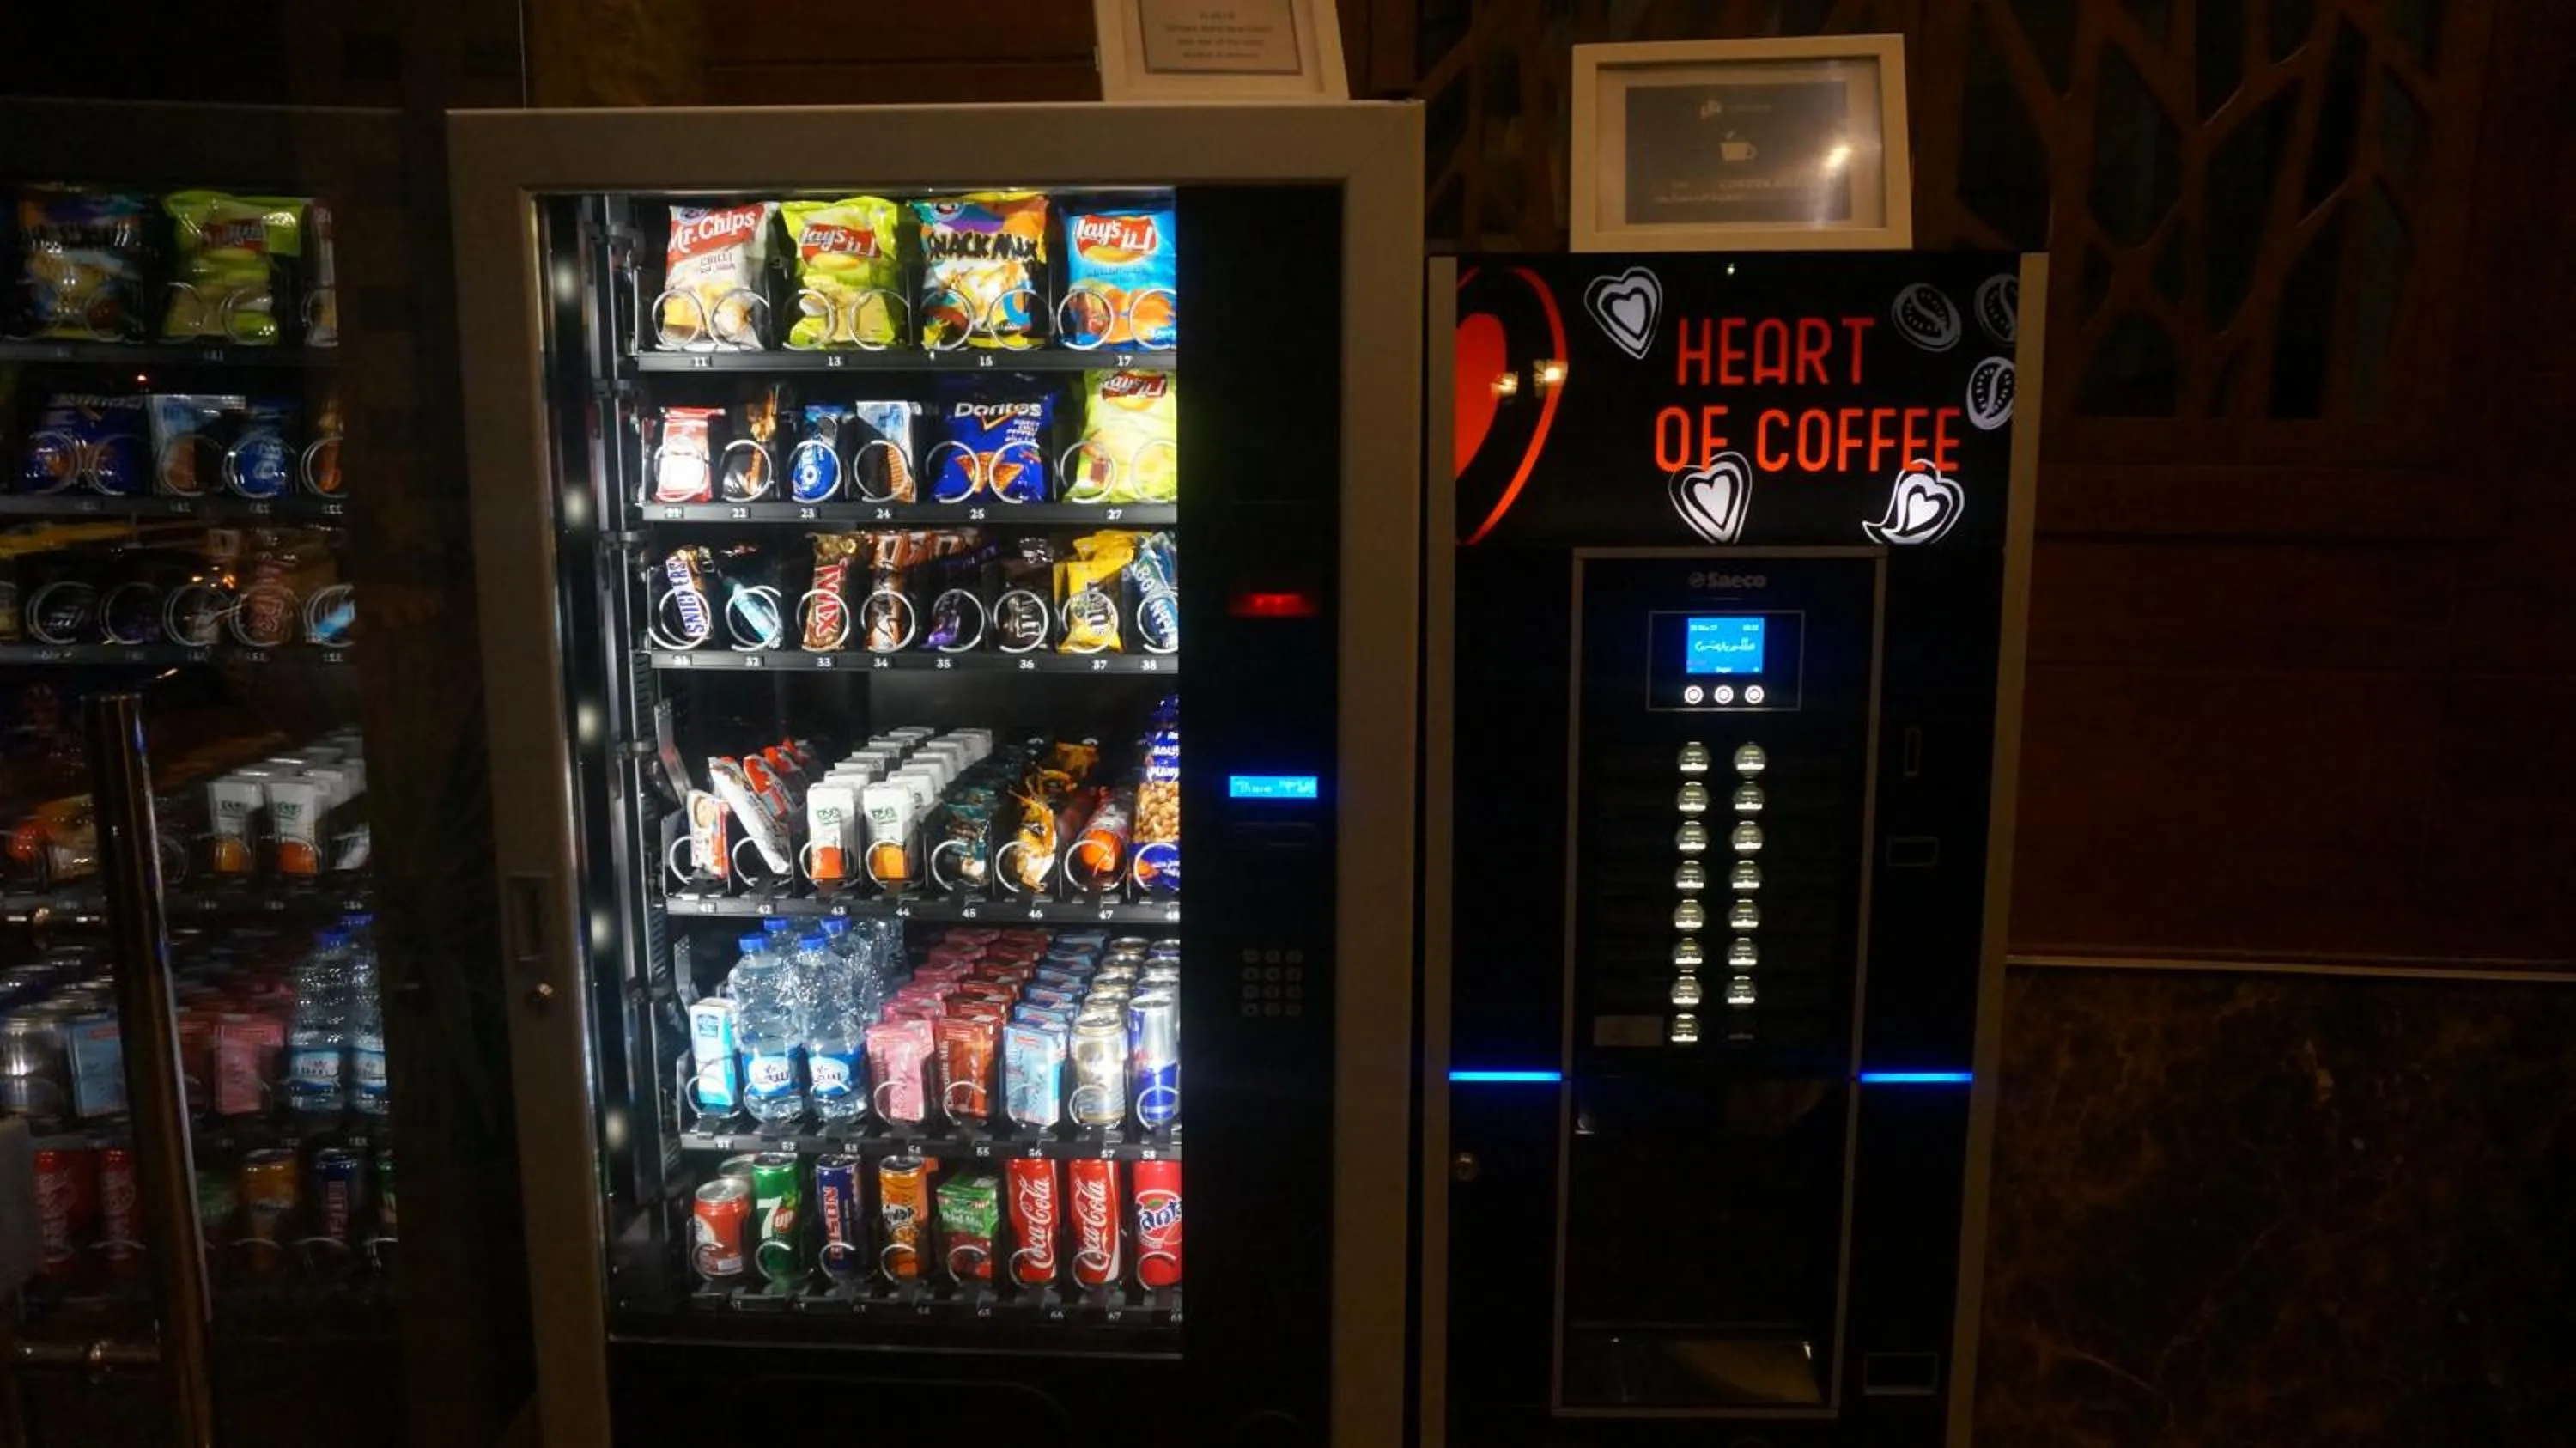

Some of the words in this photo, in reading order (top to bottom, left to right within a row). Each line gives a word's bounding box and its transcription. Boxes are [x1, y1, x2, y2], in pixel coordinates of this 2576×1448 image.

[667, 225, 698, 254] Mr.
[698, 210, 756, 240] Chips
[1677, 317, 1875, 385] HEART
[694, 356, 708, 367] 11
[828, 356, 841, 367] 13
[1117, 356, 1133, 367] 17
[954, 402, 1042, 417] Doritos
[1655, 405, 1729, 472] OF
[1756, 407, 1962, 472] COFFEE
[732, 508, 748, 518] 22
[876, 508, 891, 518] 24
[969, 508, 985, 520] 25
[1107, 508, 1123, 520] 27
[1707, 572, 1767, 588] Saeco
[816, 558, 848, 637] TWIX
[817, 656, 832, 667] 33
[873, 657, 889, 668] 34
[1019, 659, 1035, 670] 36
[1092, 659, 1108, 670] 37
[1141, 659, 1158, 671] 38
[757, 904, 774, 915] 42
[831, 906, 847, 916] 43
[896, 907, 911, 916] 44
[962, 908, 977, 919] 45
[1028, 909, 1044, 919] 46
[1098, 909, 1115, 920] 47
[908, 1145, 922, 1155] 54
[976, 1147, 990, 1157] 55
[1028, 1147, 1043, 1158] 56
[1101, 1147, 1115, 1159] 57
